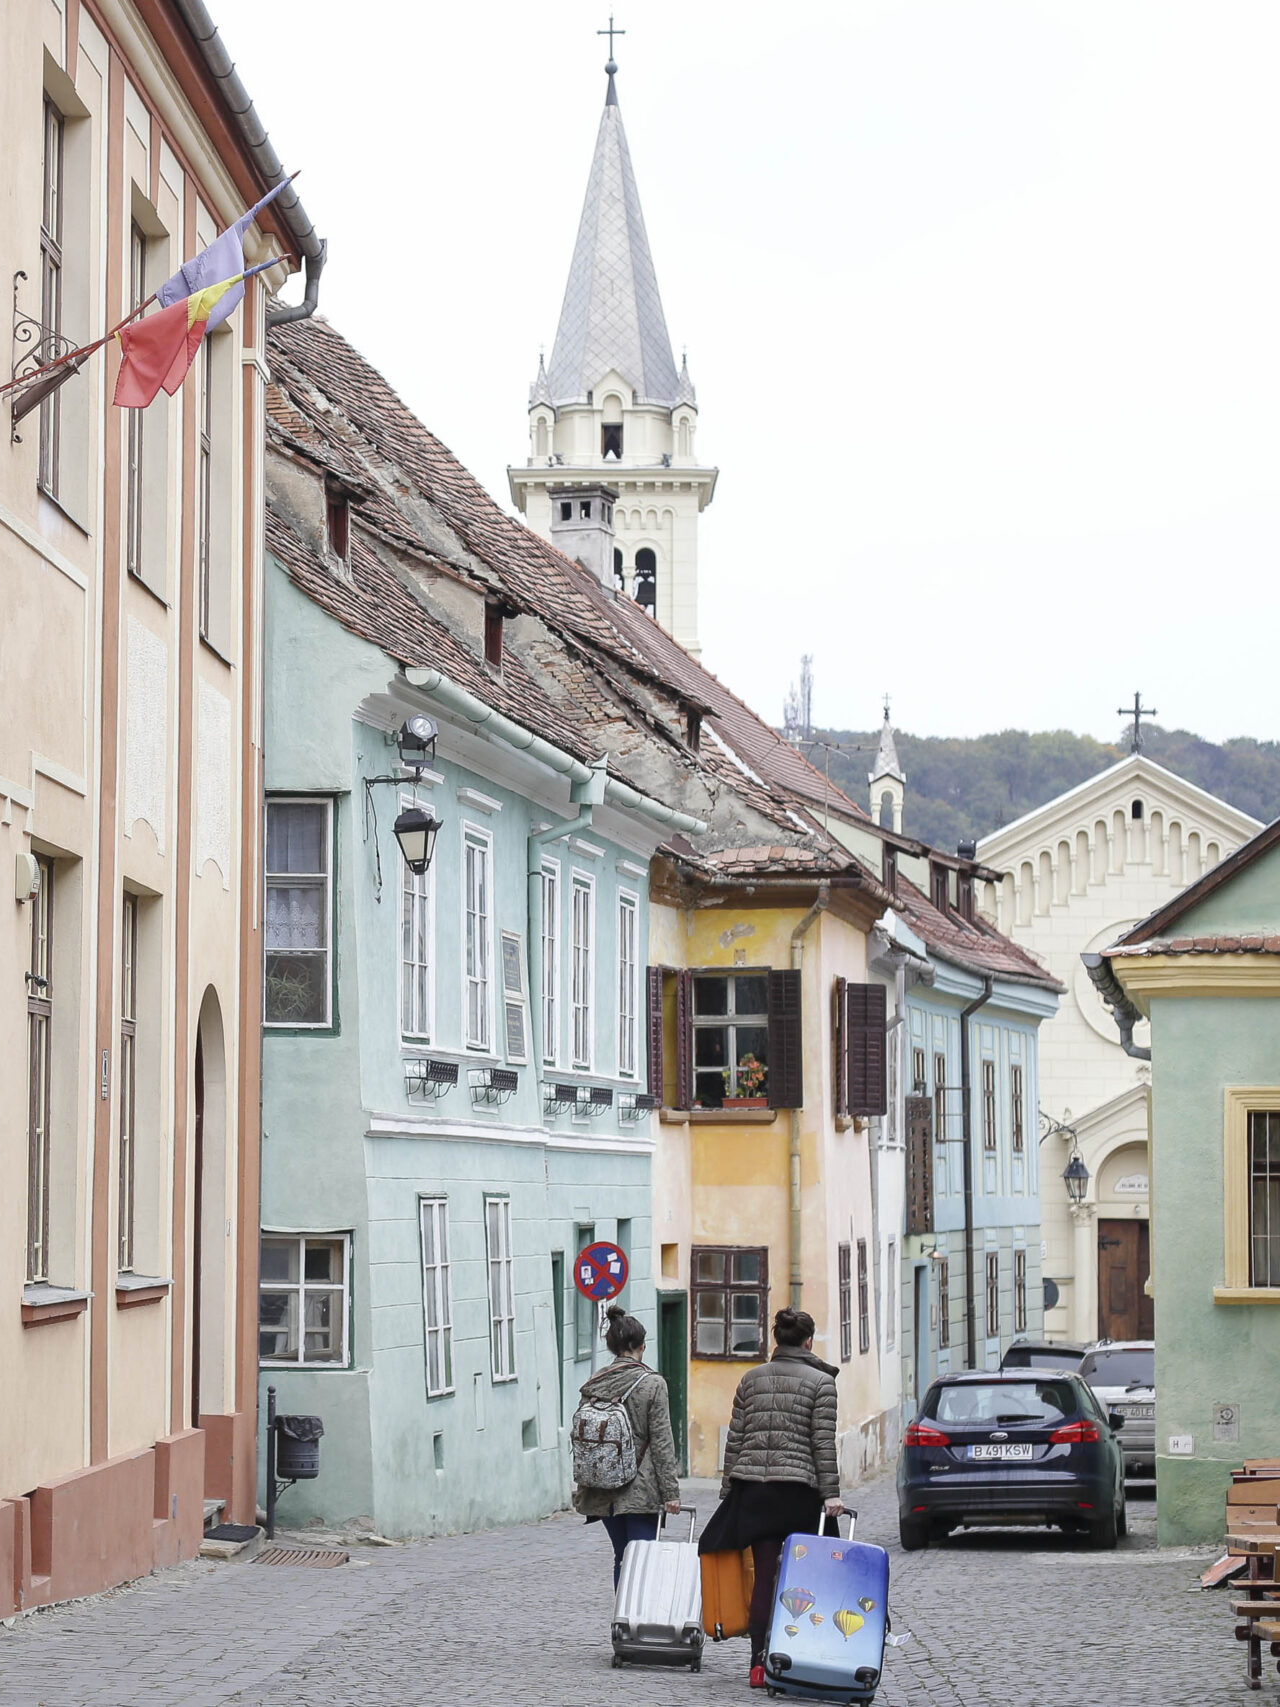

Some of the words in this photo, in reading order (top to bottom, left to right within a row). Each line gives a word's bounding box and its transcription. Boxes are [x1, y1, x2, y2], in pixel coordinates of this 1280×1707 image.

[1173, 1440, 1180, 1449] H
[974, 1446, 983, 1457] B
[985, 1445, 1003, 1456] 491
[1005, 1445, 1031, 1456] KSW
